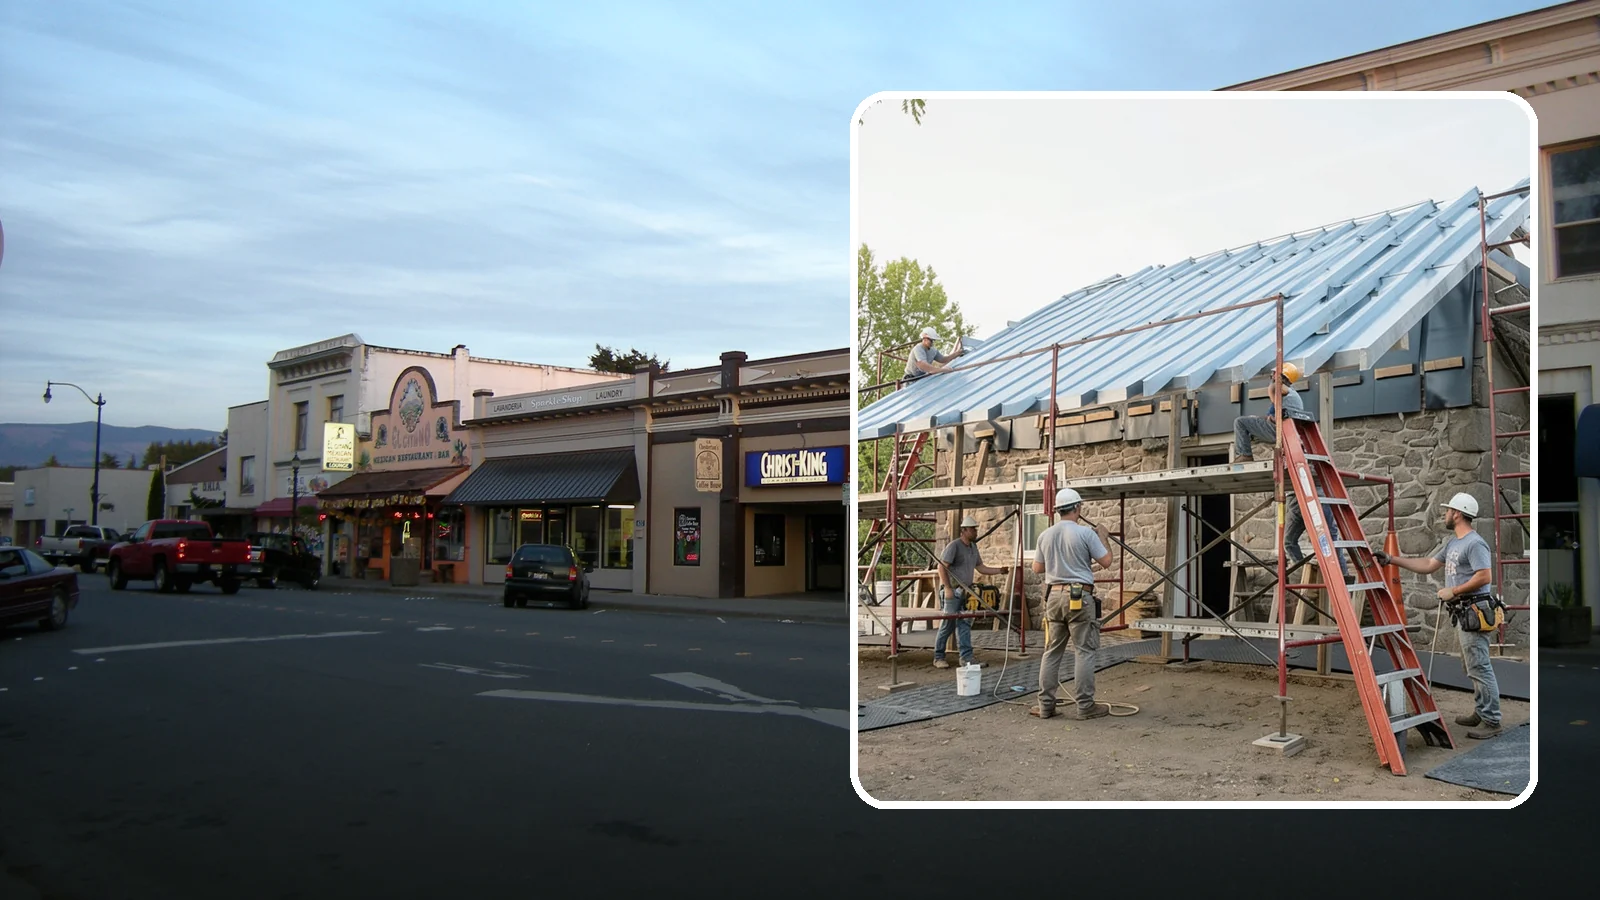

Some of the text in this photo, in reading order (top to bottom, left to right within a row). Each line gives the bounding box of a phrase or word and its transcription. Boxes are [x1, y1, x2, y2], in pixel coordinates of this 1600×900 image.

[493, 389, 623, 412] LAVANDERIA Sparkle Shop LAUNDRY
[373, 454, 396, 464] MEXICAN
[397, 451, 433, 462] RESTAURANT
[438, 450, 450, 459] BAR
[760, 450, 827, 478] CHRIST KING
